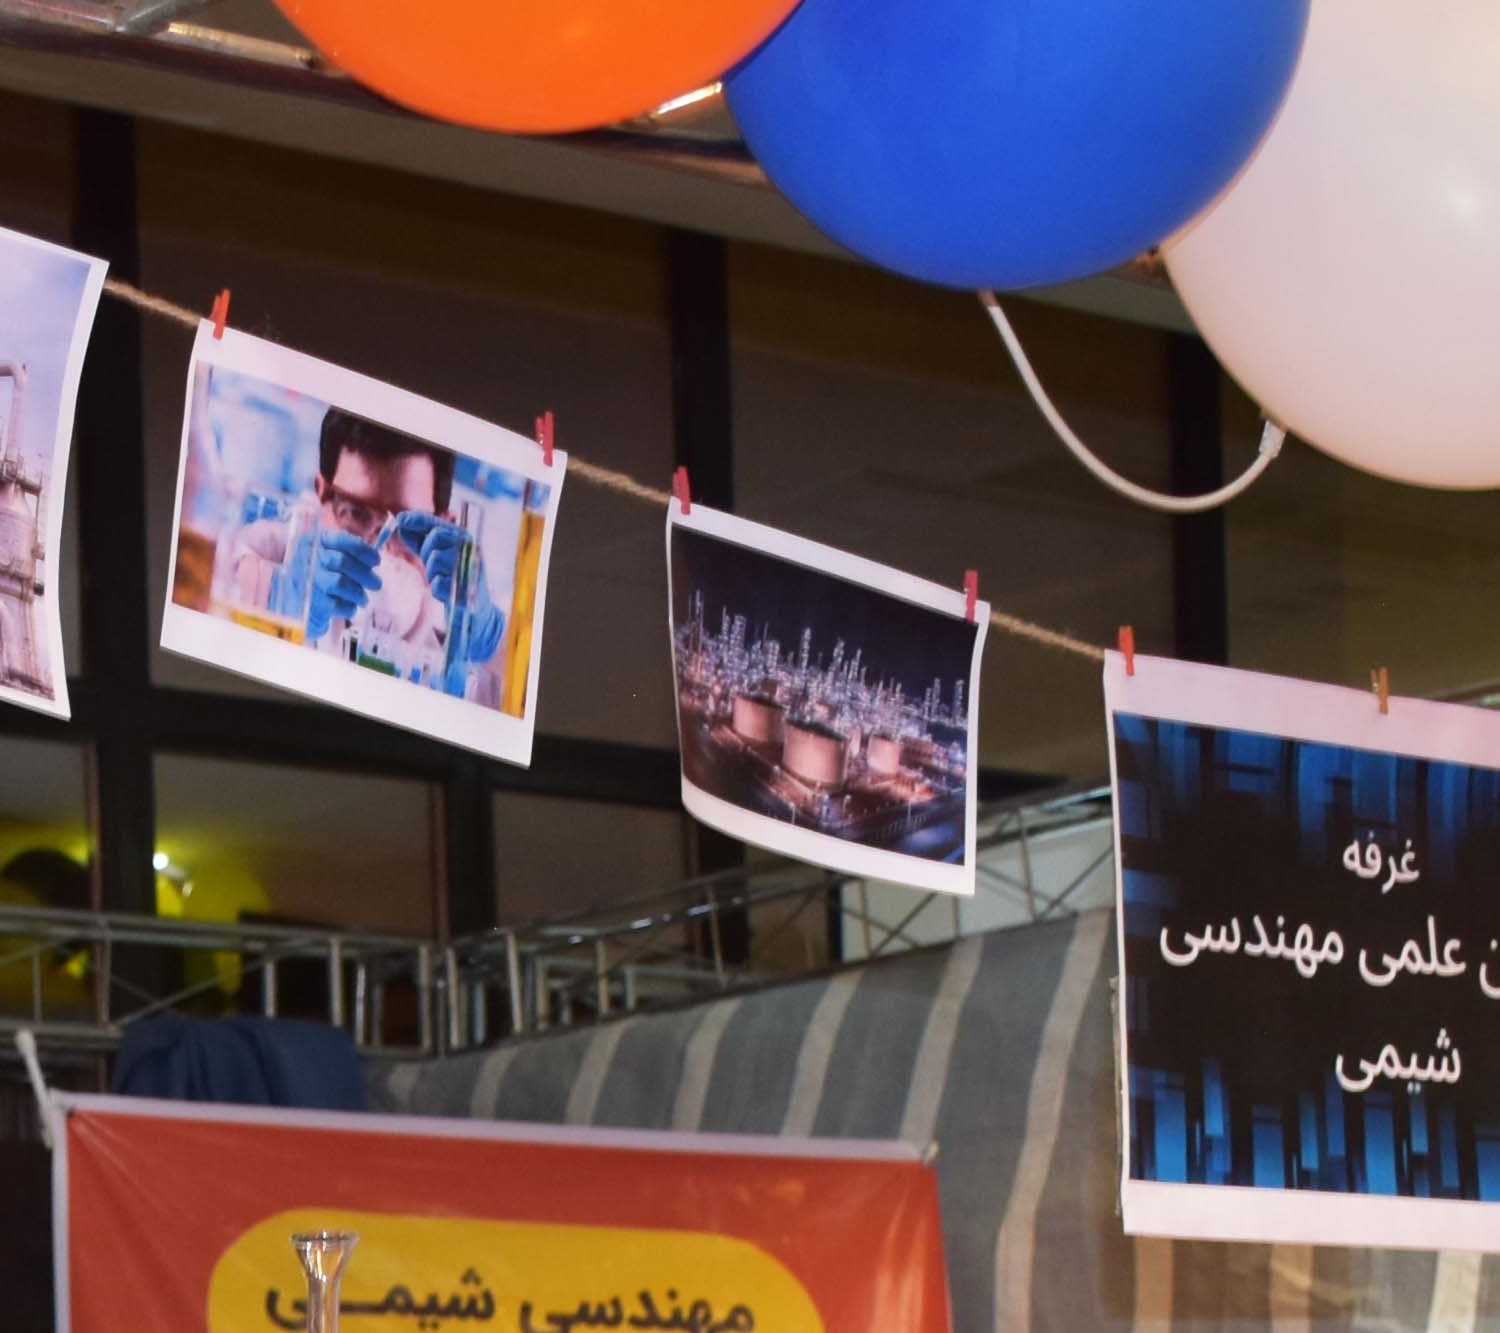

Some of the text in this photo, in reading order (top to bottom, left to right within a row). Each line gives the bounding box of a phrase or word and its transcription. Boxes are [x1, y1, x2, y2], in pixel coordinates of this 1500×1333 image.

[1342, 831, 1421, 893] غرفه
[1159, 913, 1345, 979] مهندسی
[1358, 915, 1467, 987] علمی
[1335, 1026, 1462, 1093] شیمی
